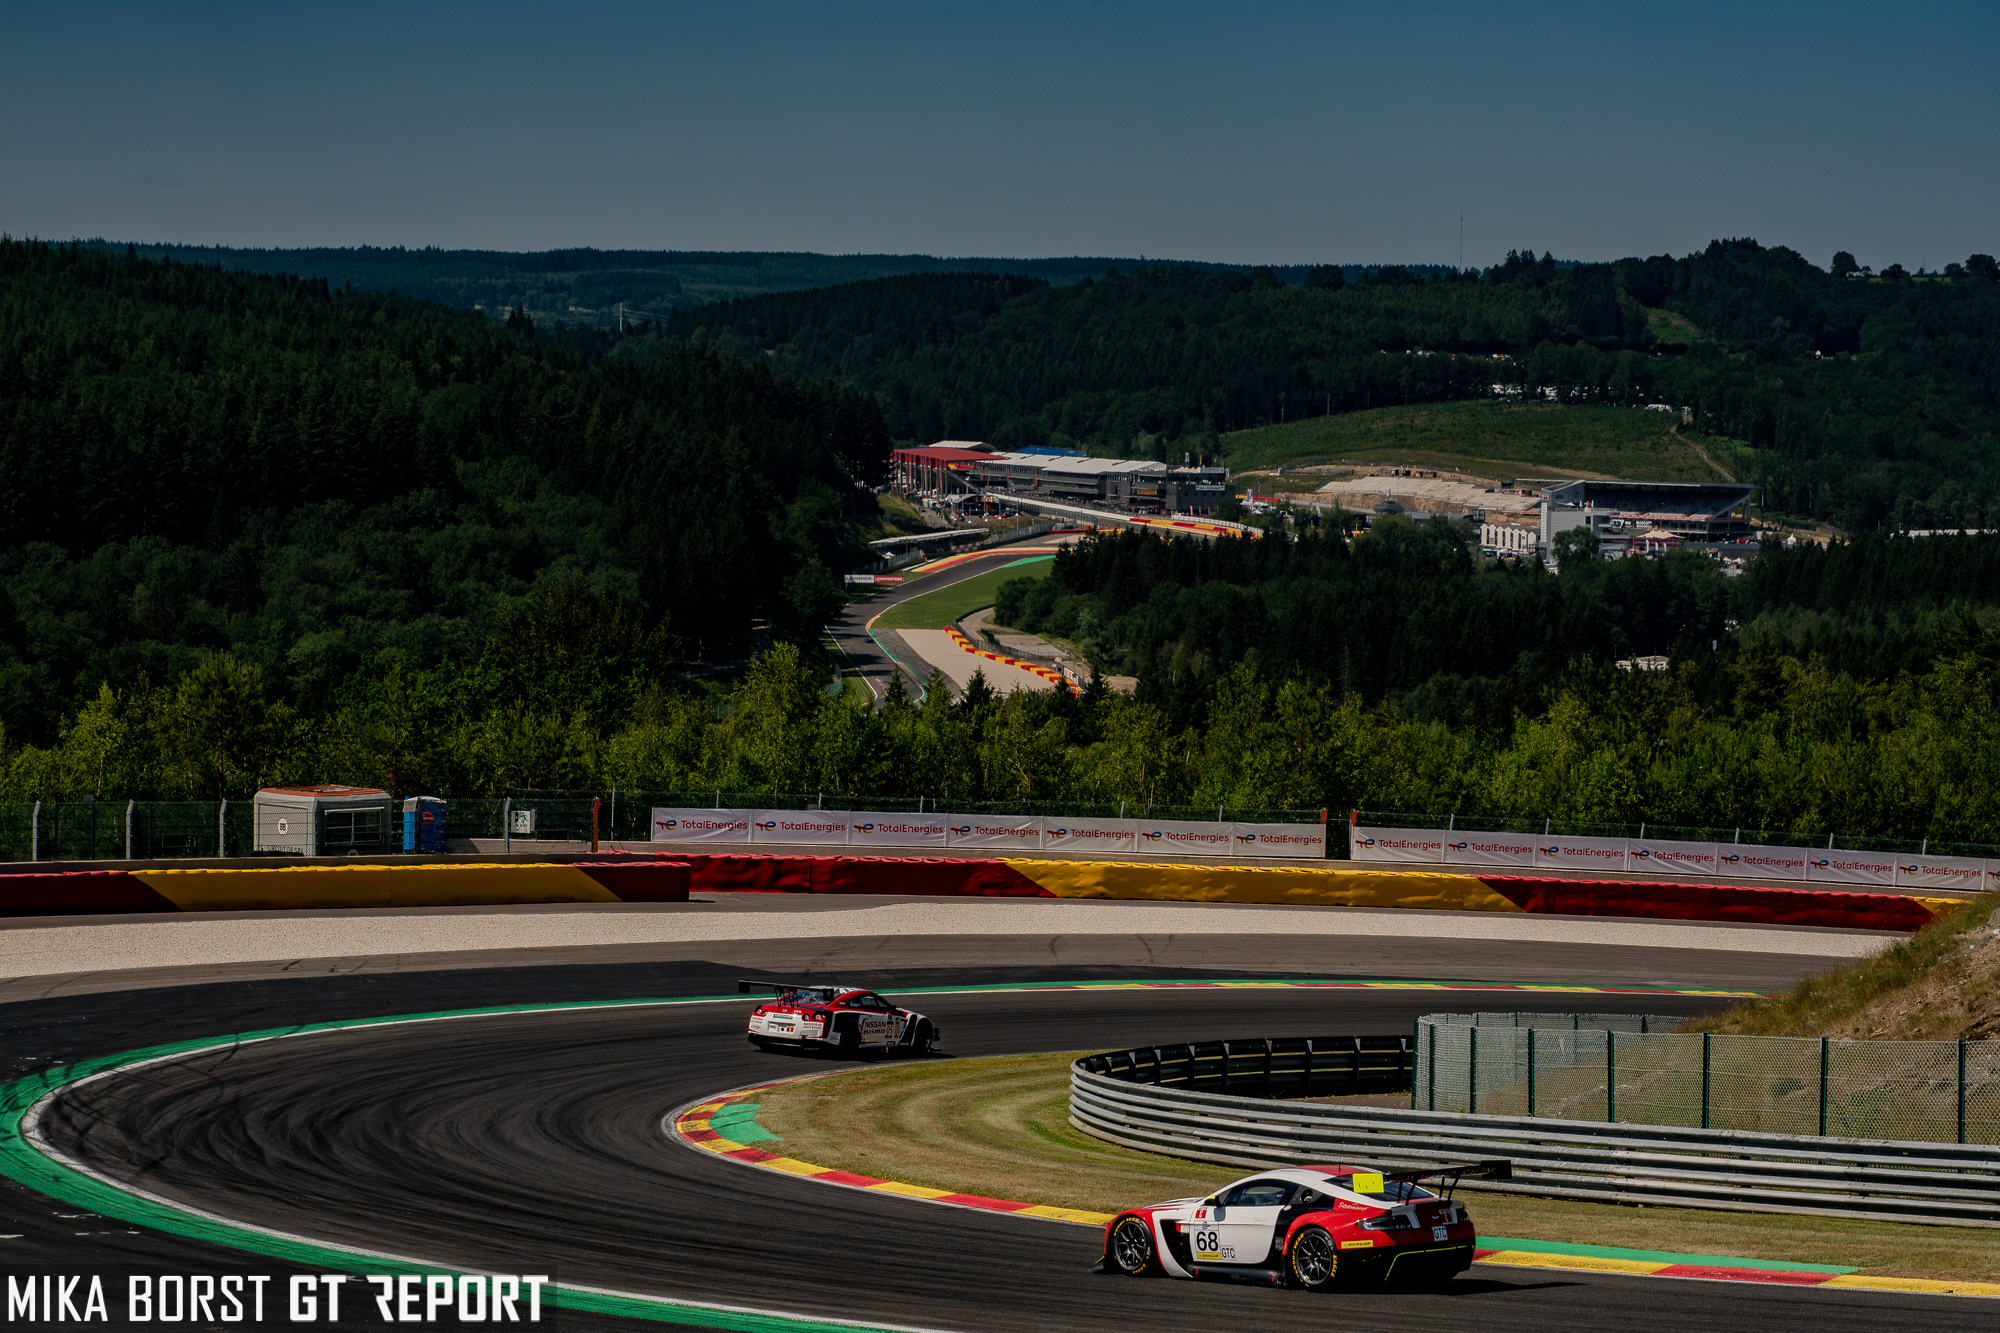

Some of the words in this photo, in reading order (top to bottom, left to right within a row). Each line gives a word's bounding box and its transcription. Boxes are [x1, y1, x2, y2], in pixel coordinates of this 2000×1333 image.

[681, 820, 748, 831] TotalEnergies
[780, 822, 846, 833] TotalEnergies
[878, 824, 943, 835] TotalEnergies
[974, 826, 1039, 838] TotalEnergies
[1071, 829, 1135, 840] TotalEnergies
[1165, 832, 1229, 843] TotalEnergies
[1259, 835, 1322, 847] TotalEnergies
[1378, 839, 1441, 851] TotalEnergies
[1471, 843, 1532, 854] TotalEnergies
[1562, 847, 1624, 859] TotalEnergies
[1654, 851, 1714, 863] TotalEnergies
[1743, 856, 1804, 868] TotalEnergies
[1832, 861, 1892, 873] TotalEnergies
[1921, 866, 1981, 878] TotalEnergies
[864, 1021, 886, 1029] NISSAN
[1337, 1201, 1368, 1212] Seaward
[1433, 1228, 1448, 1239] GTC
[1196, 1231, 1219, 1252] 68
[1221, 1247, 1236, 1259] GTC
